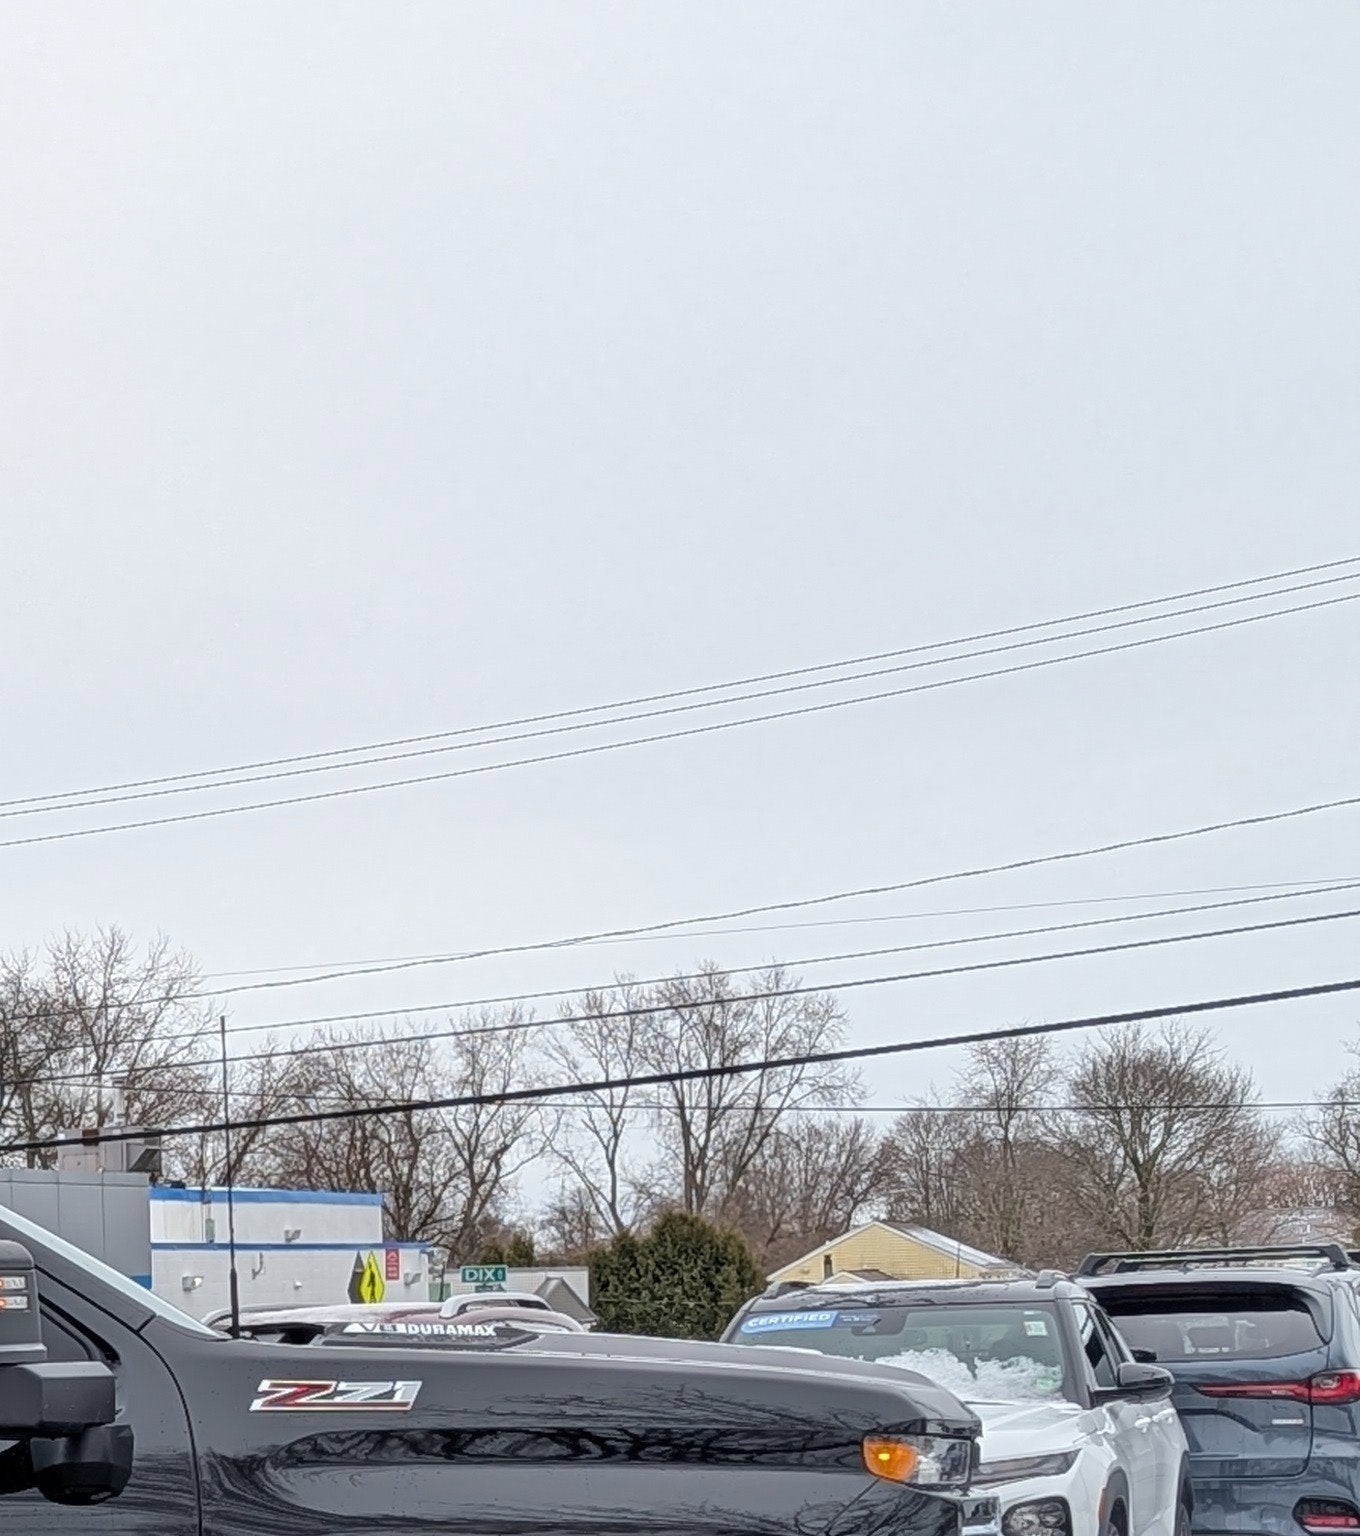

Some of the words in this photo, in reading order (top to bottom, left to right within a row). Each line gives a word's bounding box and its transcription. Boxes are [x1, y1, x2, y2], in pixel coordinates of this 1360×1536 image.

[465, 1268, 496, 1281] DIX
[747, 1313, 831, 1327] CERTIFIED
[408, 1323, 497, 1337] DURAMAX
[249, 1379, 423, 1412] Z71
